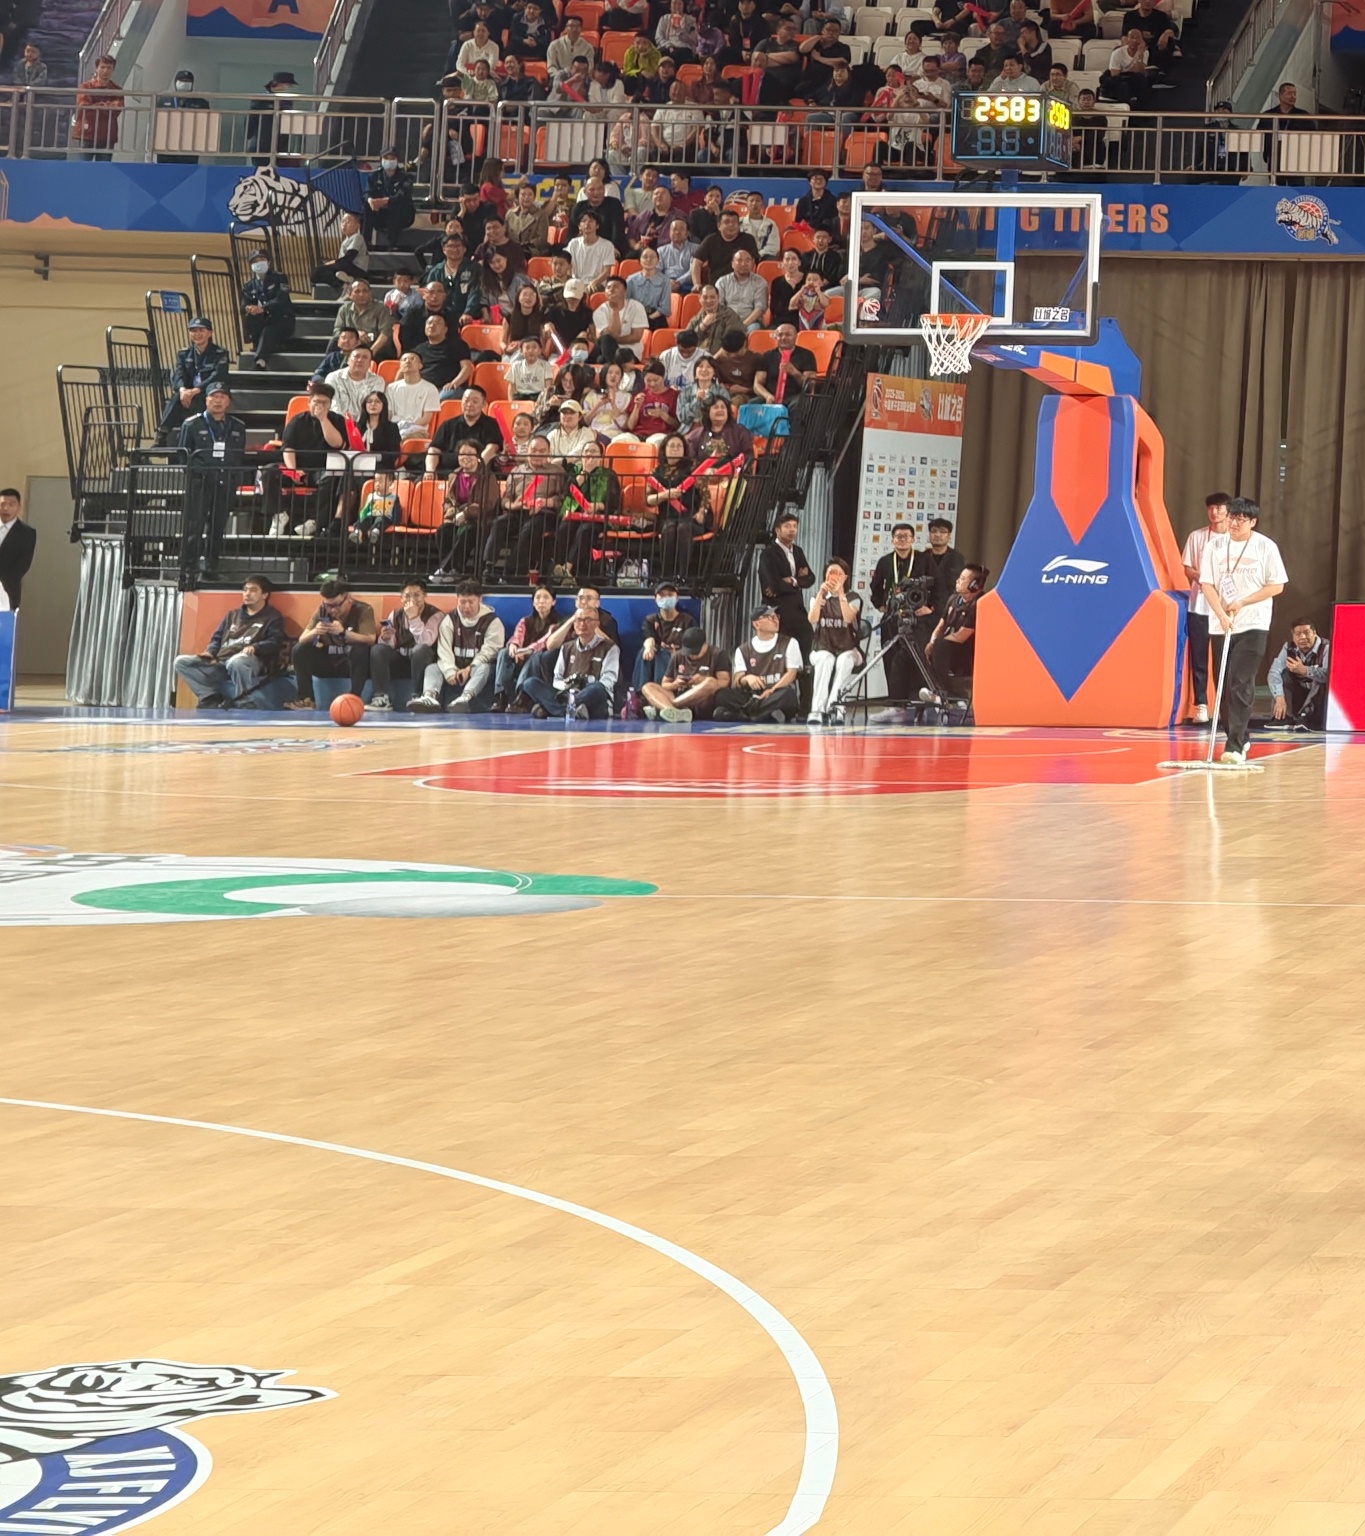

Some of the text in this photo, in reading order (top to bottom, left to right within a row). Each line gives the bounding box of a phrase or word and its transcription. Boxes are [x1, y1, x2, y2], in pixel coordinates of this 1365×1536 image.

[1034, 307, 1070, 321] 以城之名
[1041, 572, 1109, 585] LI-NING
